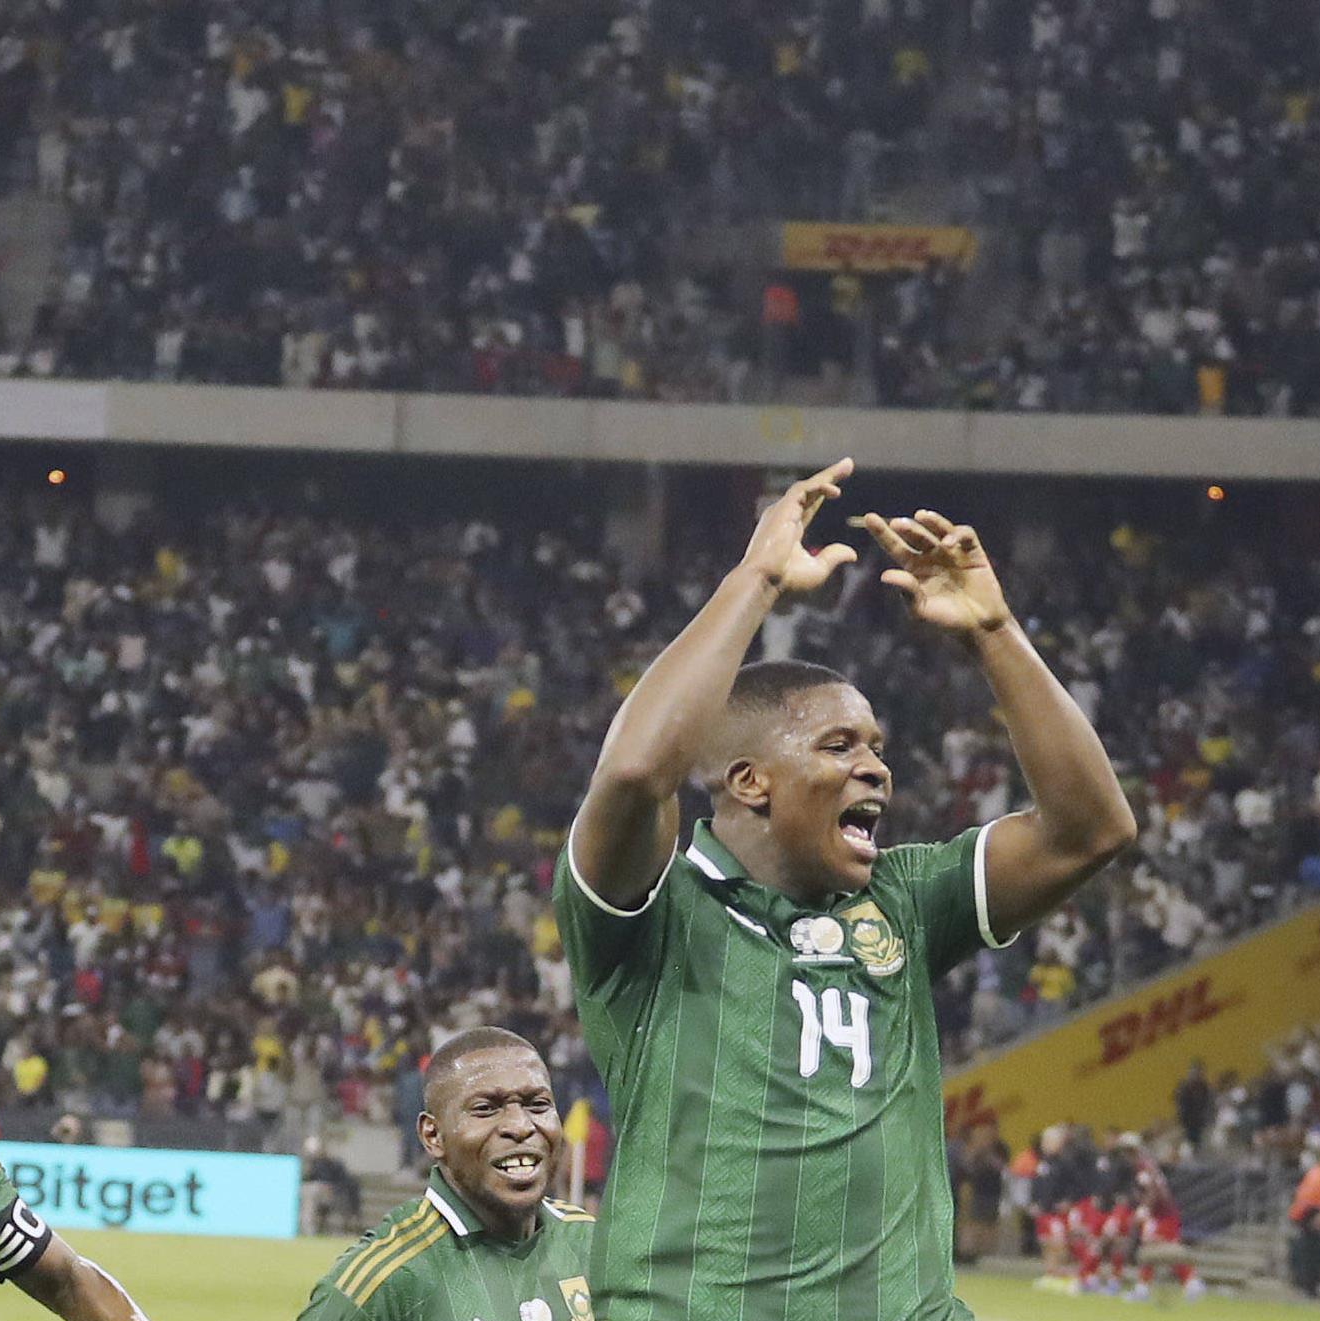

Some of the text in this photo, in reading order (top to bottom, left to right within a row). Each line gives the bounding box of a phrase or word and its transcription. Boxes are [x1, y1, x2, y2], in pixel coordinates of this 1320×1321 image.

[791, 978, 872, 1089] 14
[1098, 976, 1221, 1065] DHL
[11, 1163, 203, 1227] Bitget
